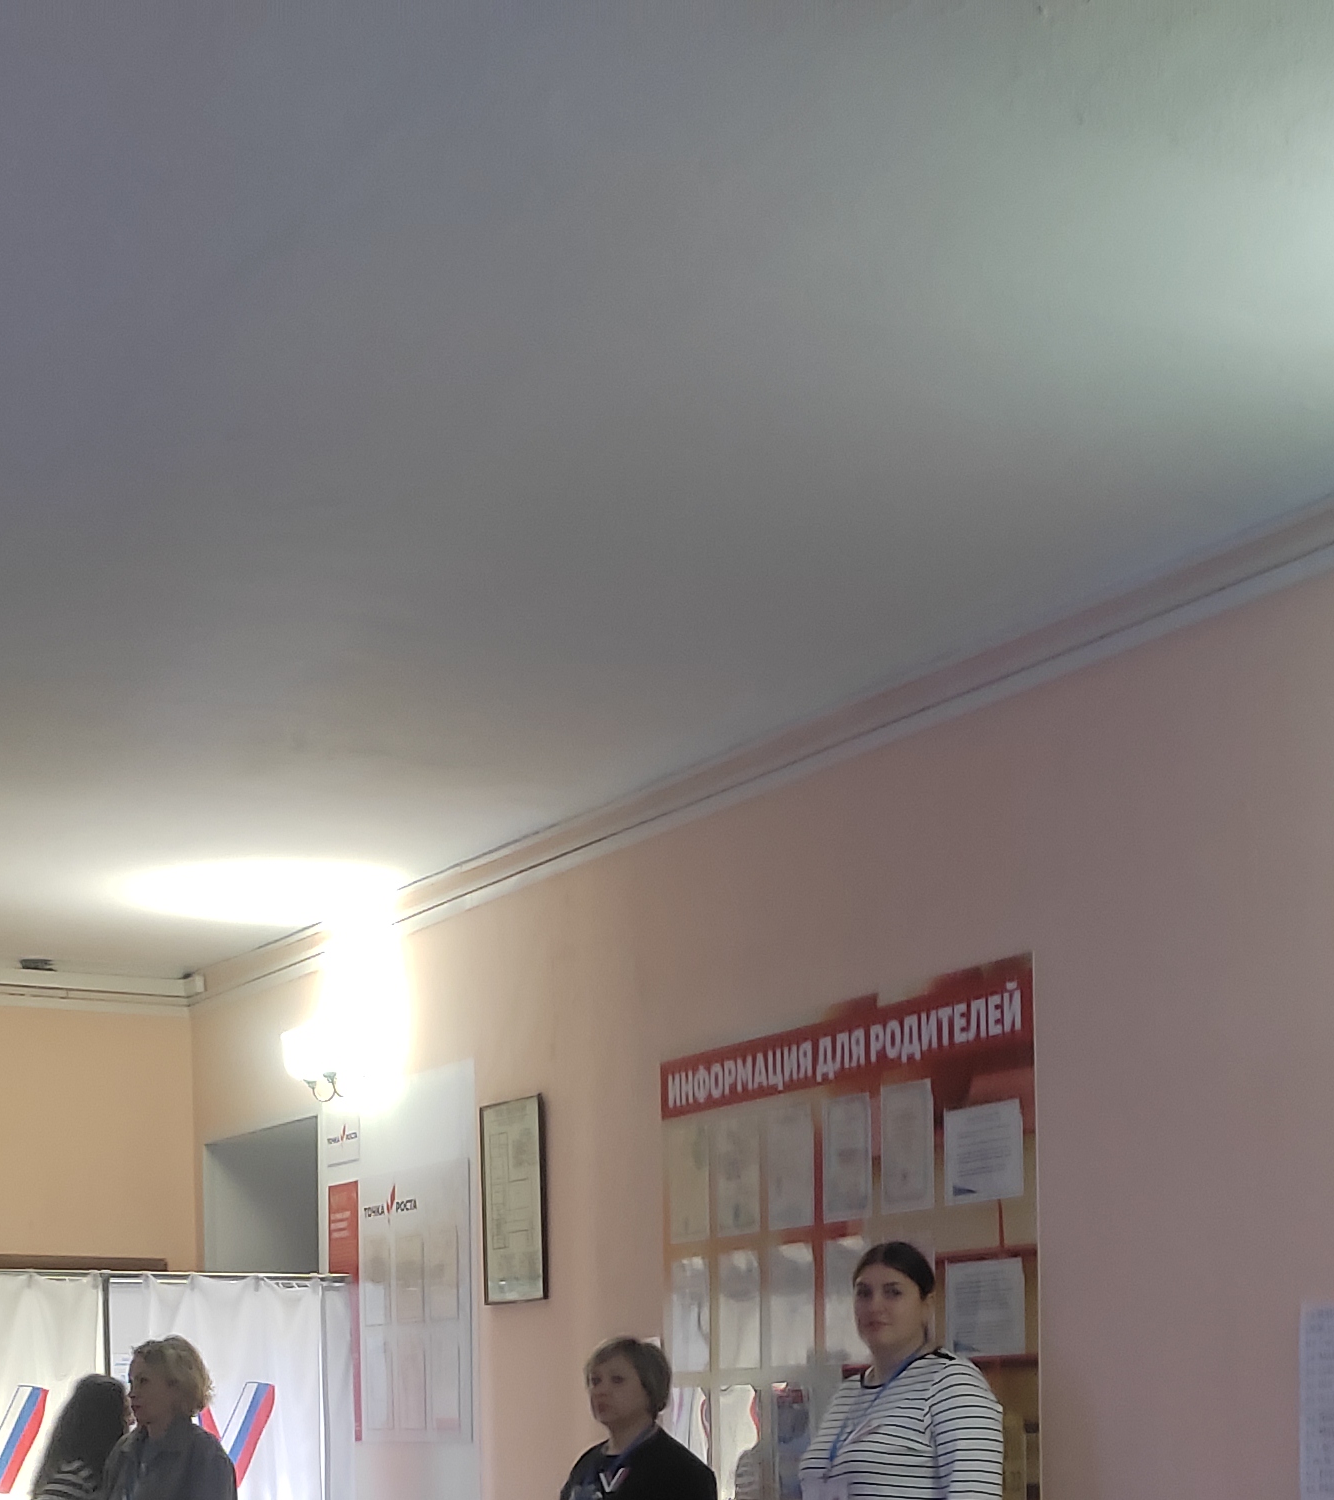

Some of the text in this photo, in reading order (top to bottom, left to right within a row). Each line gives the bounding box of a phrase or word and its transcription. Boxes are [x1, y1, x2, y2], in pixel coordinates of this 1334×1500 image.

[667, 980, 1022, 1109] ИНФОРМАЦИЯ ДЛЯ РОДИТЕЛЕЙ
[364, 1198, 417, 1218] ТОЧКА РОСТА
